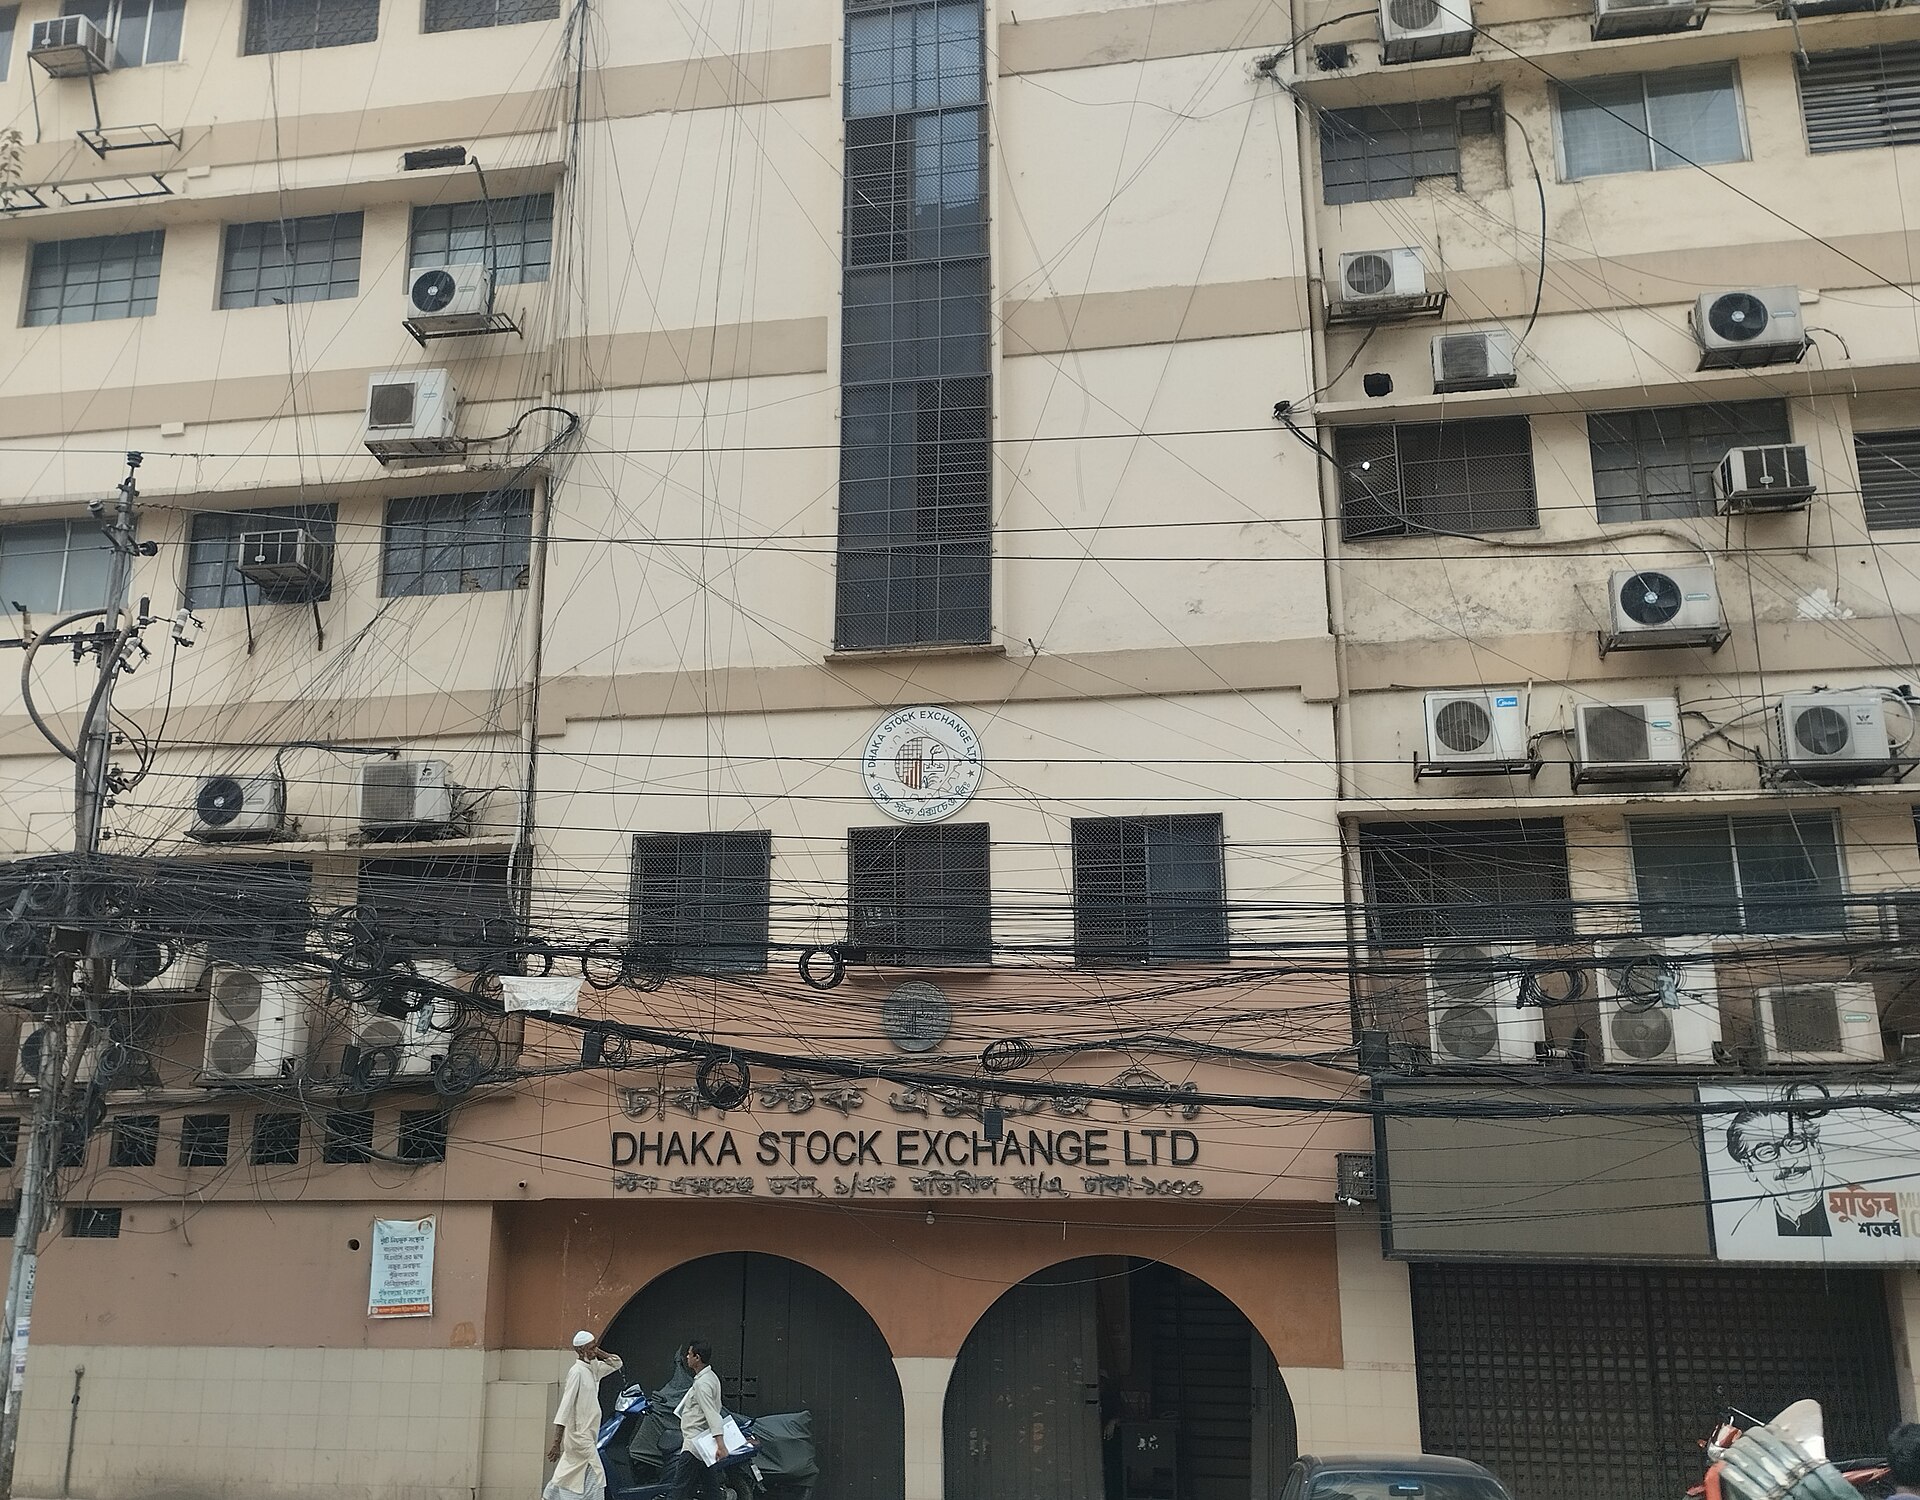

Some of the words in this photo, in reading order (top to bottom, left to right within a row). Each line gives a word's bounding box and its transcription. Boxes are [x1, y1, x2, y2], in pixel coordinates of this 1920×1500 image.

[867, 733, 886, 768] DHAKA
[884, 711, 916, 733] STOCK
[920, 710, 972, 744] EXCHANGE
[611, 1130, 742, 1166] DHAKA
[756, 1130, 882, 1166] STOCK
[897, 1130, 1110, 1166] EXCHANGE
[1123, 1129, 1200, 1166] LTD
[1828, 1184, 1899, 1223] মুজিব
[1857, 1218, 1902, 1238] শতবর্ষ
